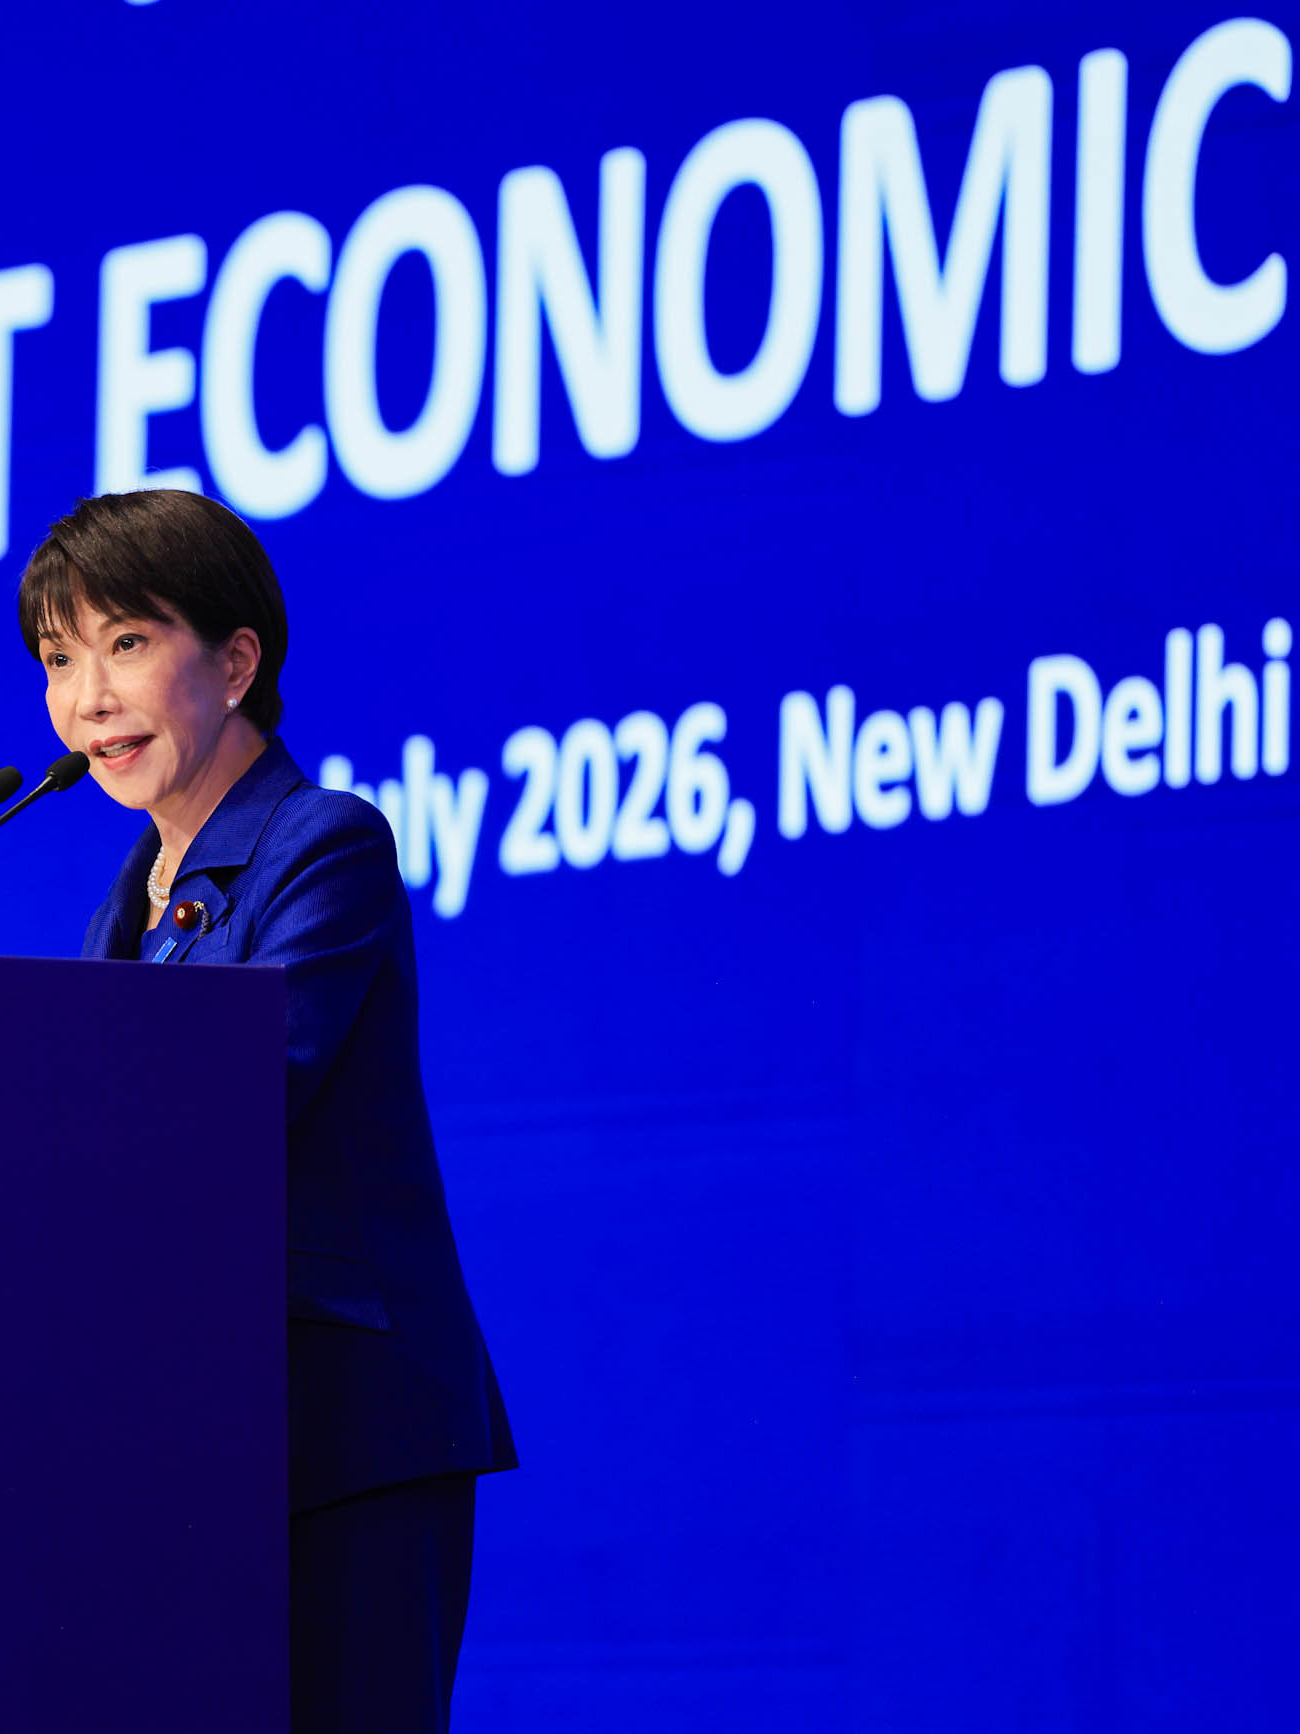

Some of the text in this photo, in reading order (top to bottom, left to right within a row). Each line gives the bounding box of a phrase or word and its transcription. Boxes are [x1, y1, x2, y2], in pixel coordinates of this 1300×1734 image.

[94, 17, 1292, 519] ECONOMIC
[320, 617, 1292, 918] ly 2026, New Delhi
